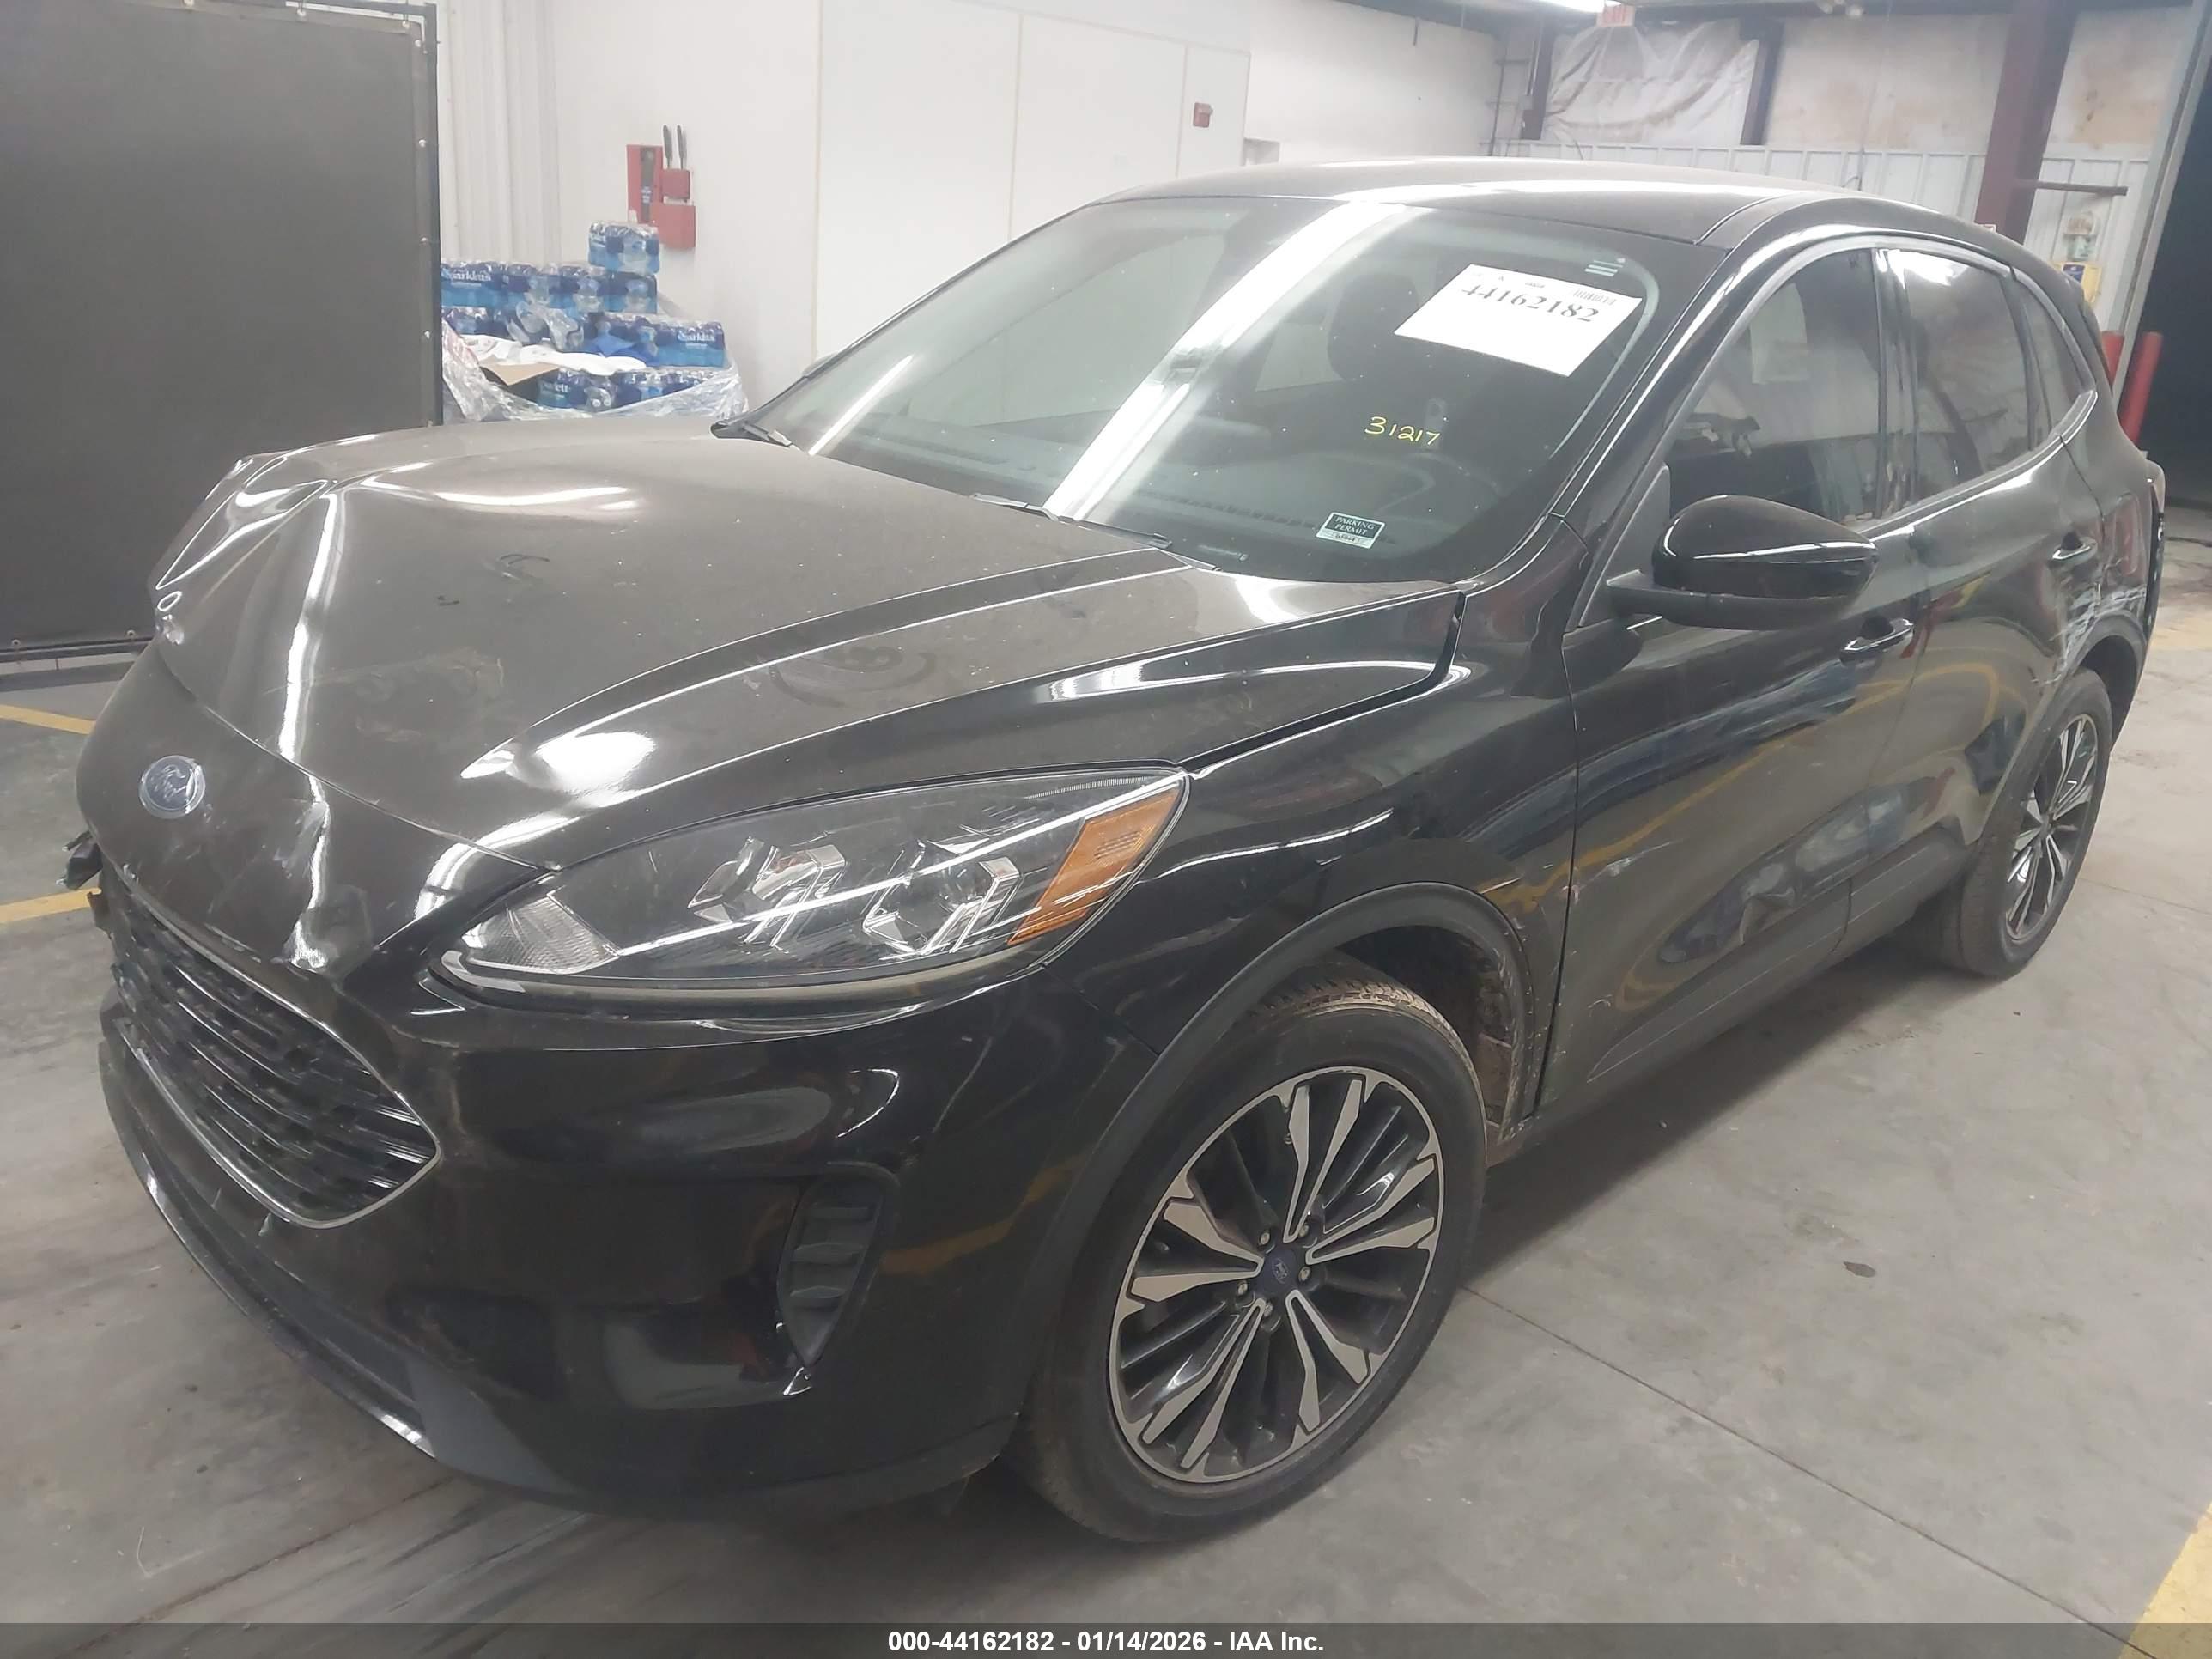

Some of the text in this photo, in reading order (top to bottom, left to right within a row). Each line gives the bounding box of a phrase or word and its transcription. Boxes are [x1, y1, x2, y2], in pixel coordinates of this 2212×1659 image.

[1462, 284, 1599, 323] 44162182
[1364, 416, 1441, 446] 31217
[1334, 524, 1368, 535] PERMIT
[1335, 517, 1375, 530] PARKING
